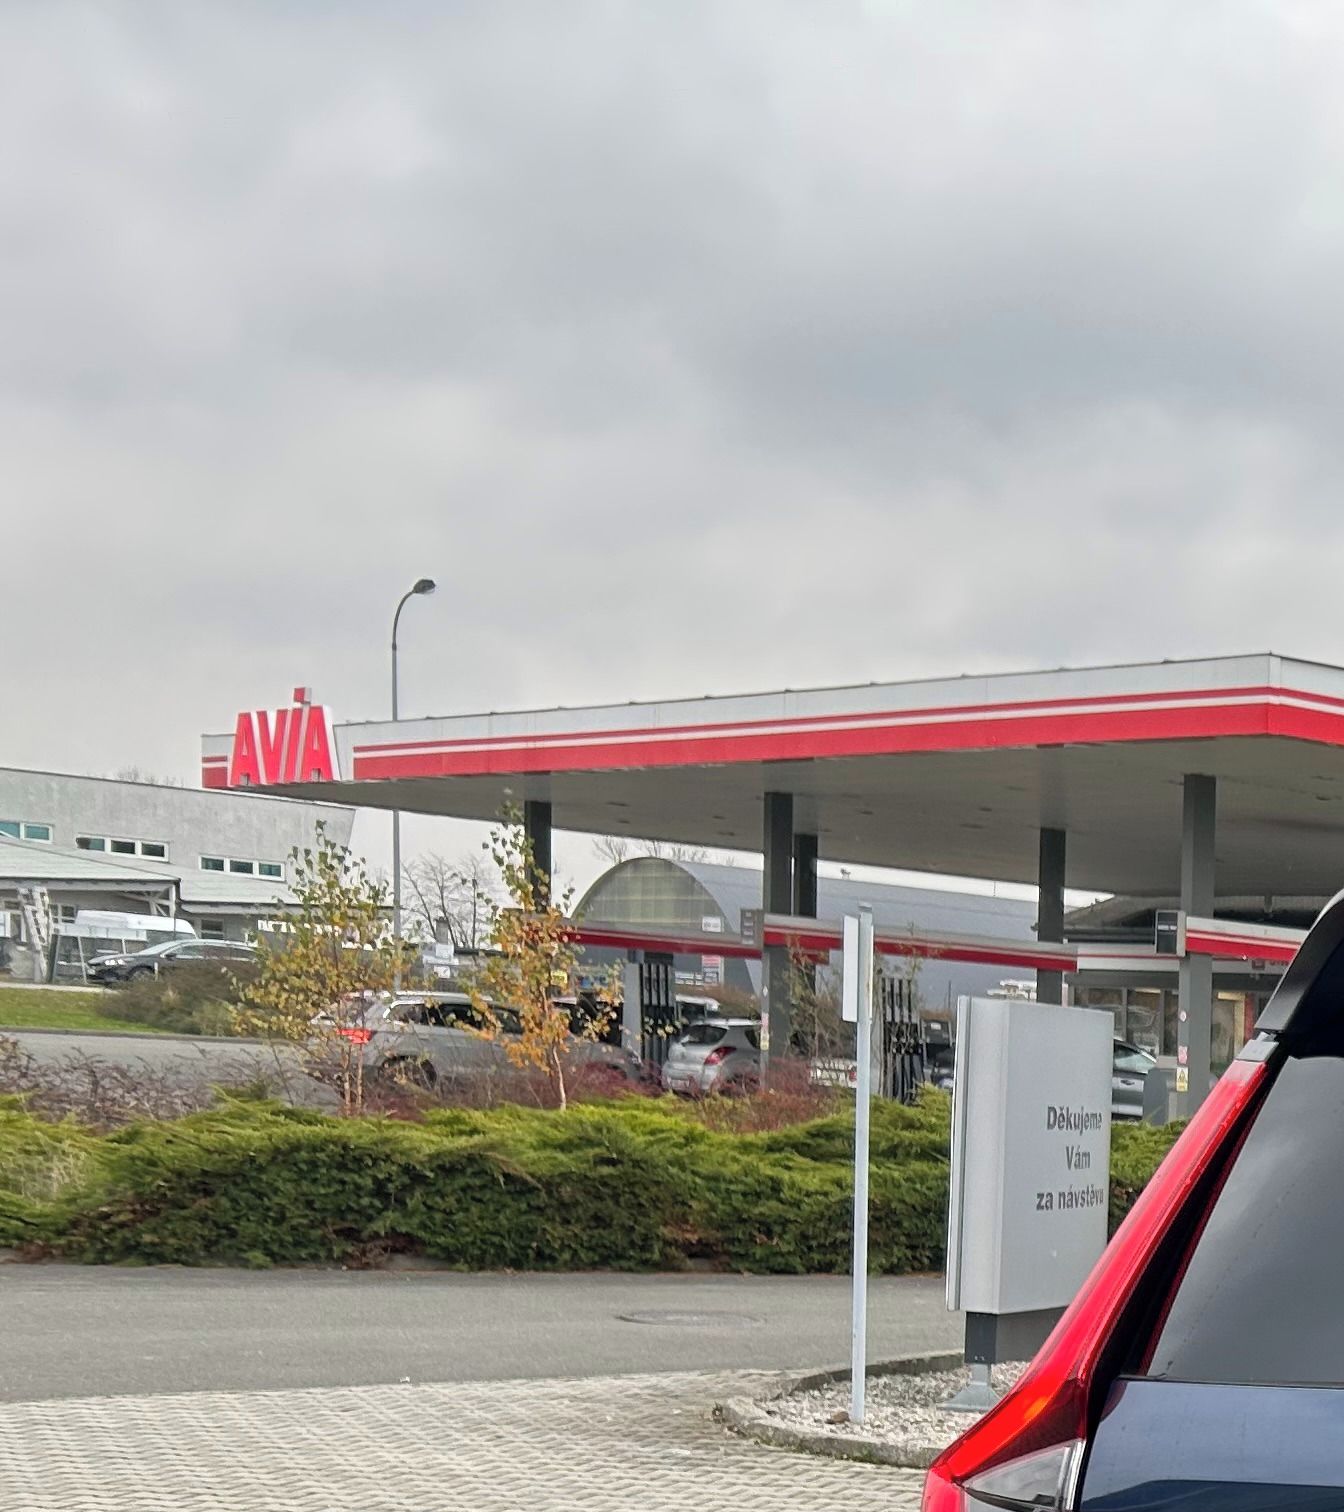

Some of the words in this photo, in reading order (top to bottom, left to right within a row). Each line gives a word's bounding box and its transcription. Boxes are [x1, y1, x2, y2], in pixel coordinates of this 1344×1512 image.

[229, 687, 339, 786] AVIA
[1047, 1105, 1102, 1135] Děkujeme
[1066, 1145, 1091, 1170] Vám
[1036, 1192, 1053, 1211] za
